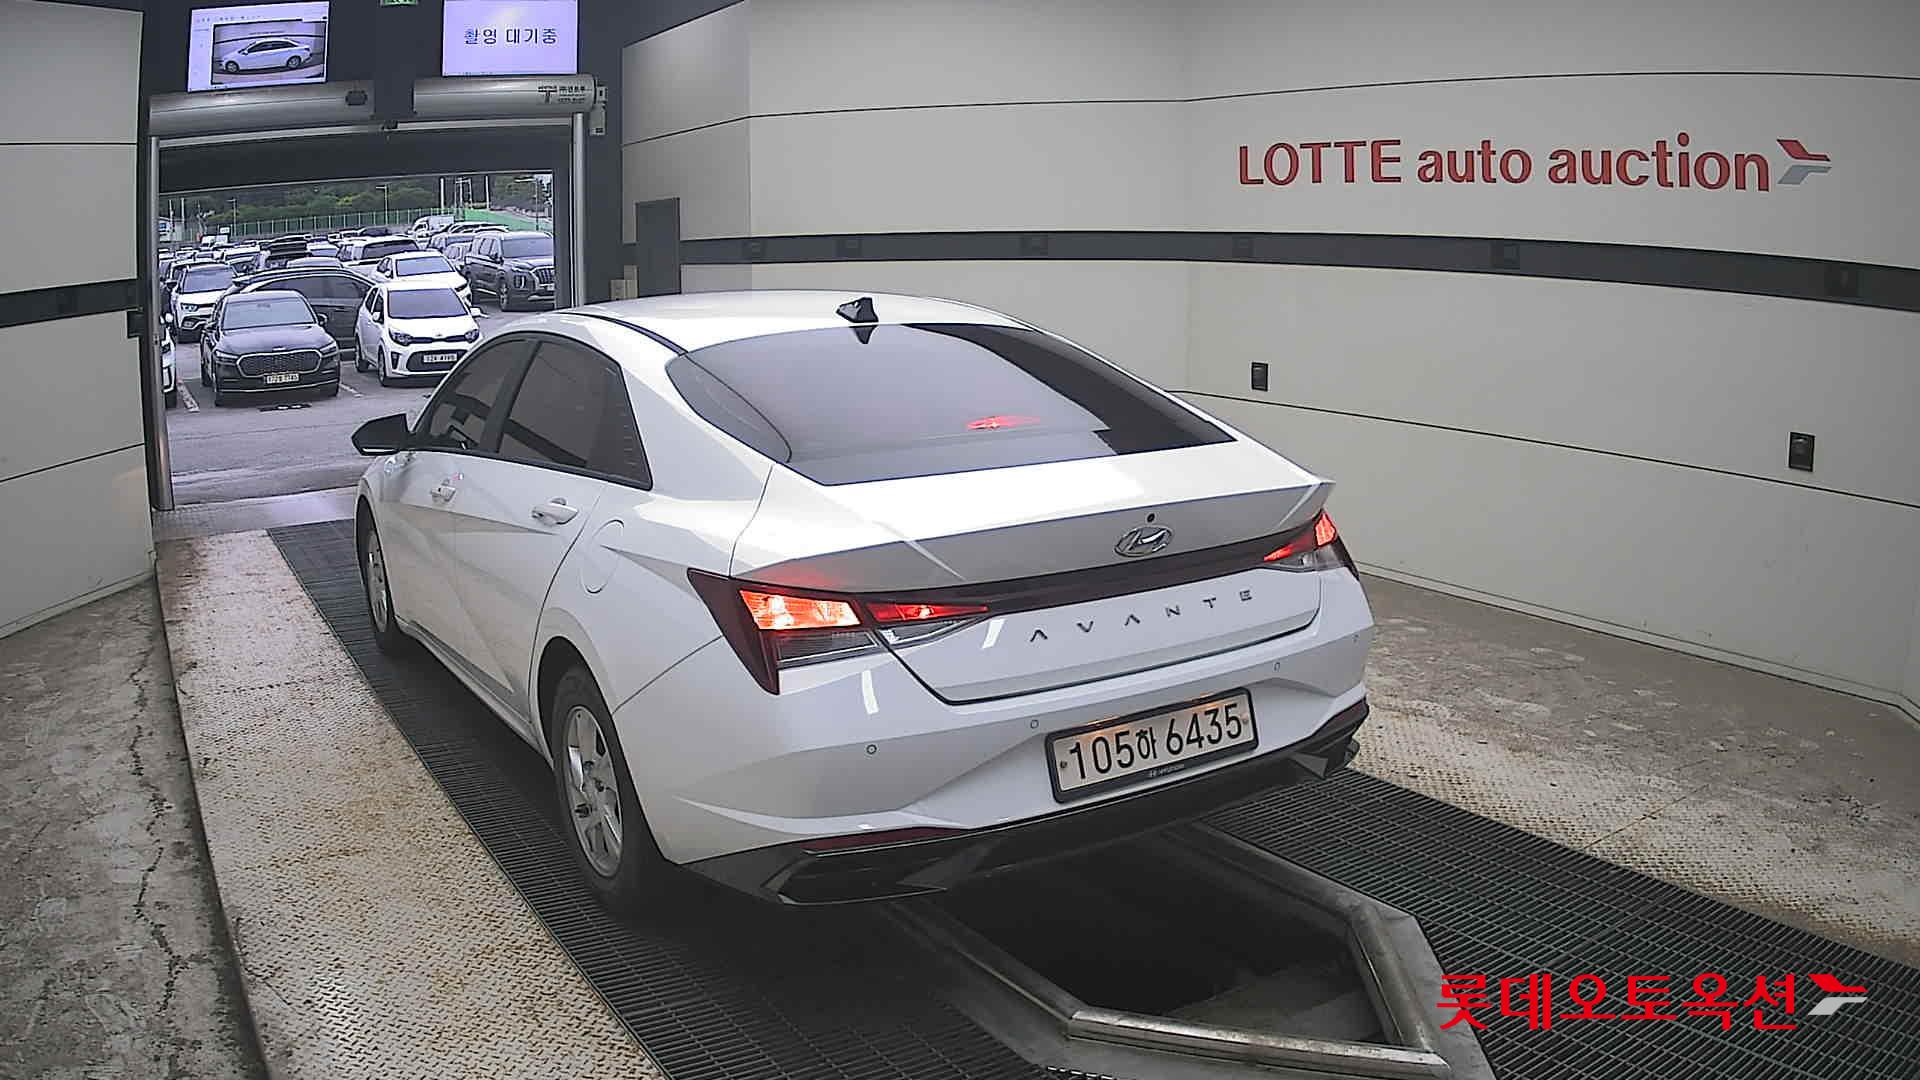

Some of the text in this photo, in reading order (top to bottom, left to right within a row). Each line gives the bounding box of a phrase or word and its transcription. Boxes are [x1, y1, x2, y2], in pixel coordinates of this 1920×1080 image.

[505, 28, 558, 45] 대기중
[1239, 132, 1770, 191] LOTTE auto auction
[1029, 589, 1253, 643] AVANTE
[1069, 702, 1243, 780] 105하 6435
